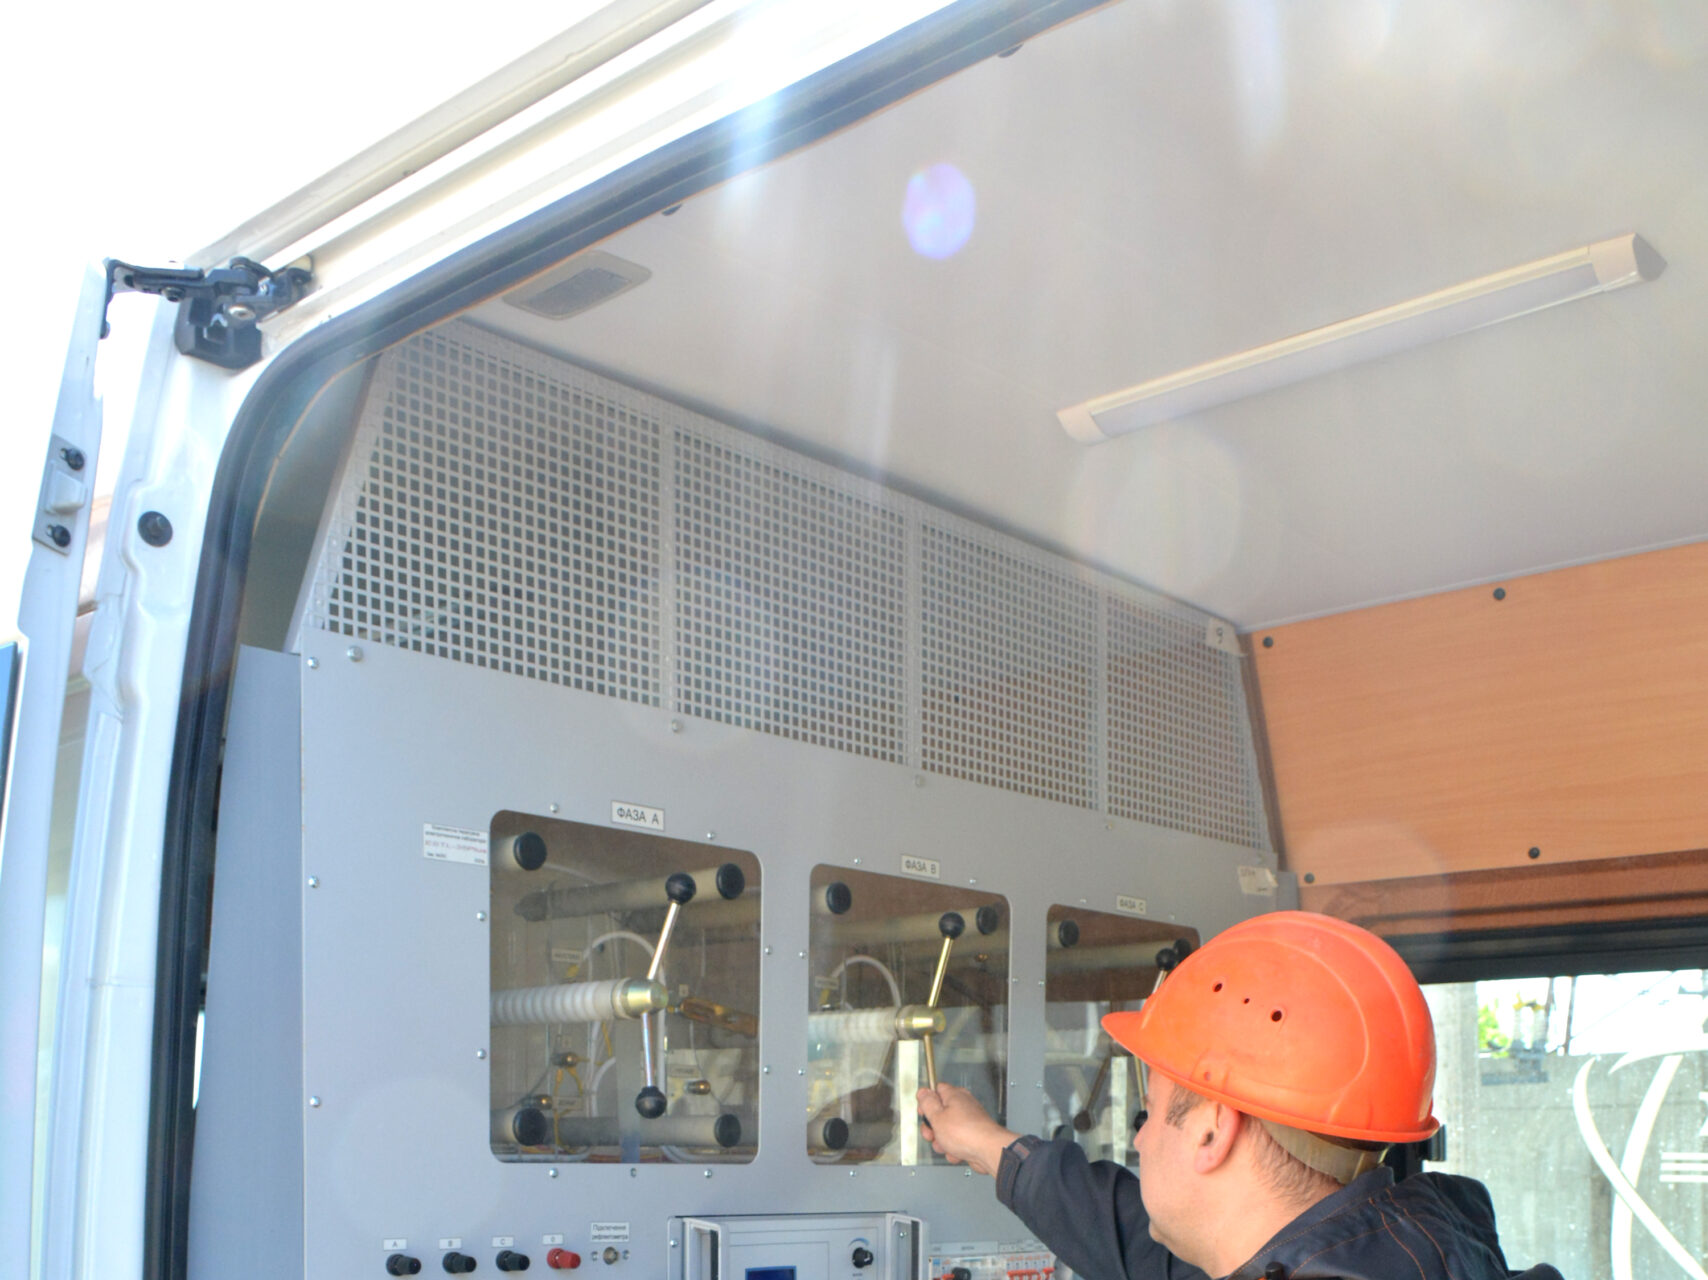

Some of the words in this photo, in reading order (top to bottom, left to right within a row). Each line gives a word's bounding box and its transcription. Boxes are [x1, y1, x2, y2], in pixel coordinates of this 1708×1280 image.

[616, 805, 647, 823] ФАЗА
[651, 812, 660, 825] А
[904, 859, 928, 873] ФАЗА
